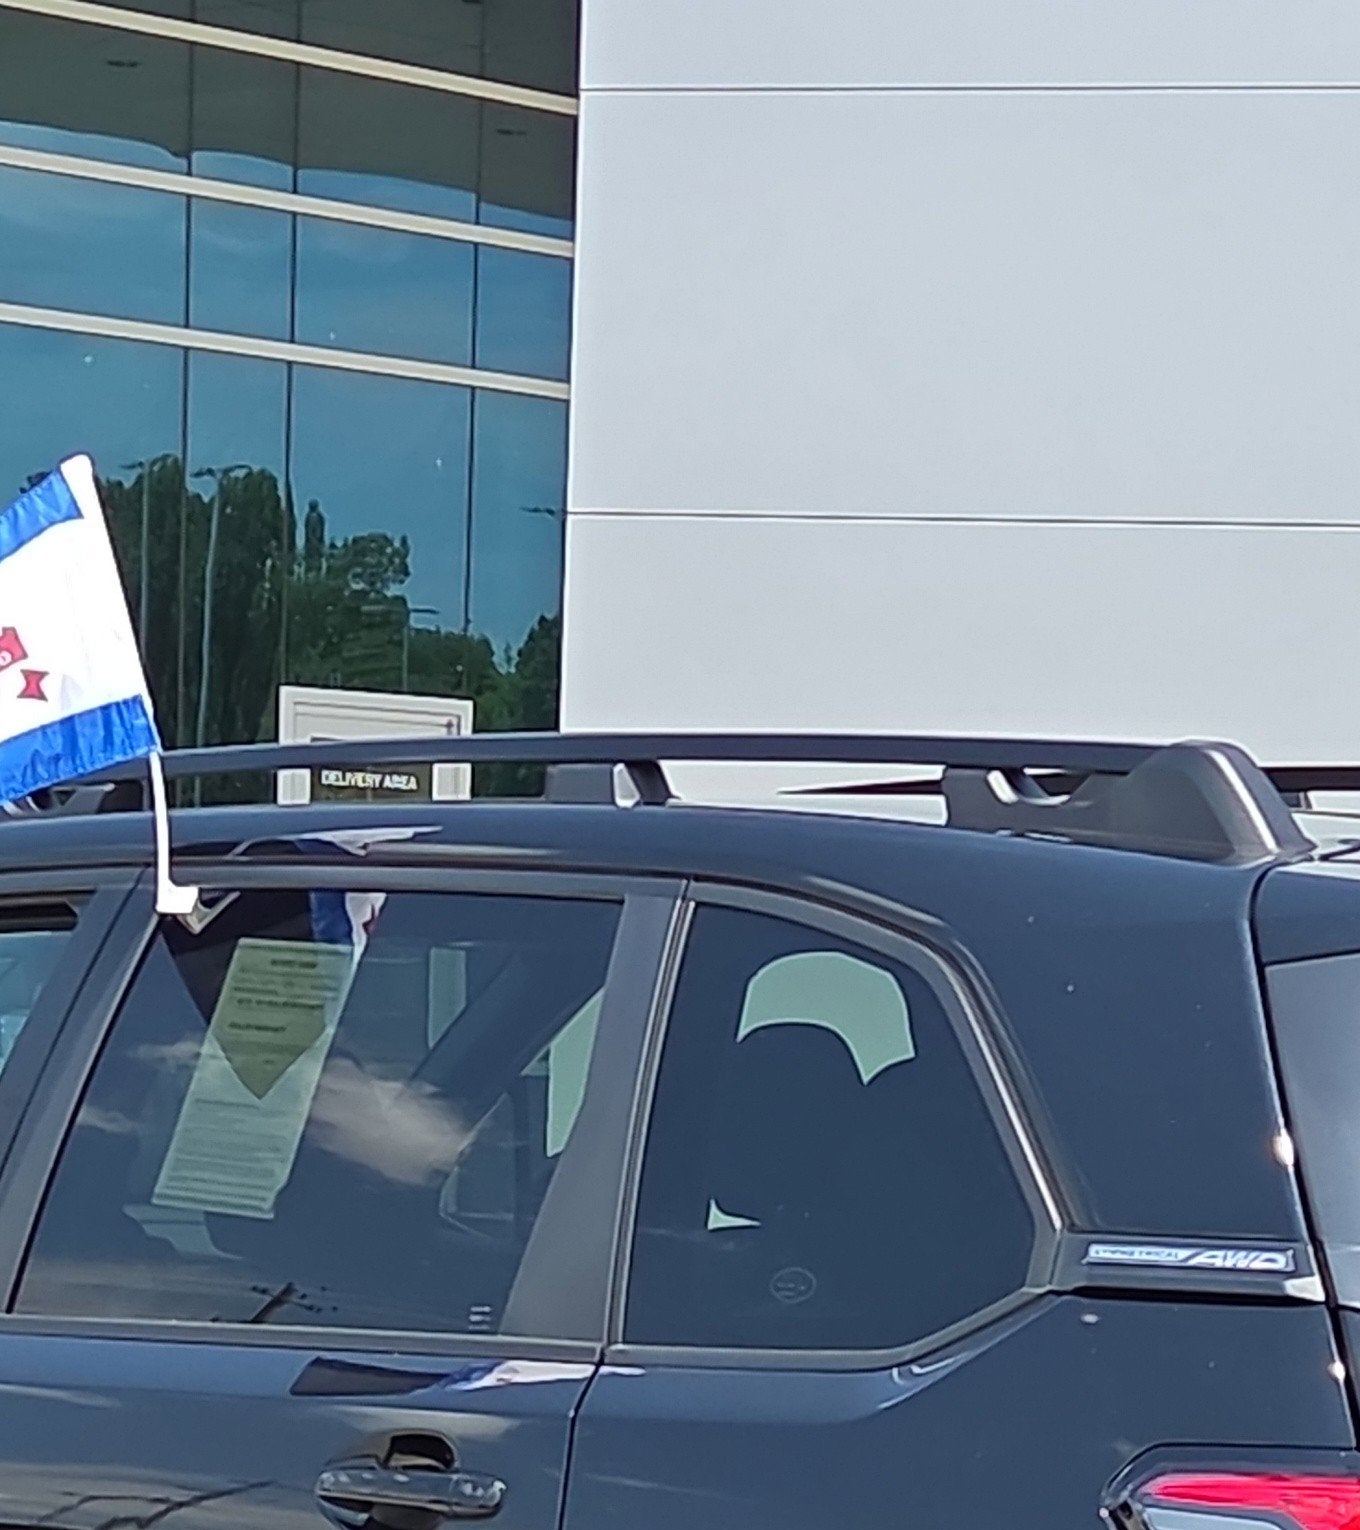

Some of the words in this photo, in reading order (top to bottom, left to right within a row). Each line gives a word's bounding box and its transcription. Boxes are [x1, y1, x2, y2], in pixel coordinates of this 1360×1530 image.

[321, 769, 382, 789] DELIVERY
[383, 773, 419, 791] AREA
[1187, 1249, 1289, 1270] AWD
